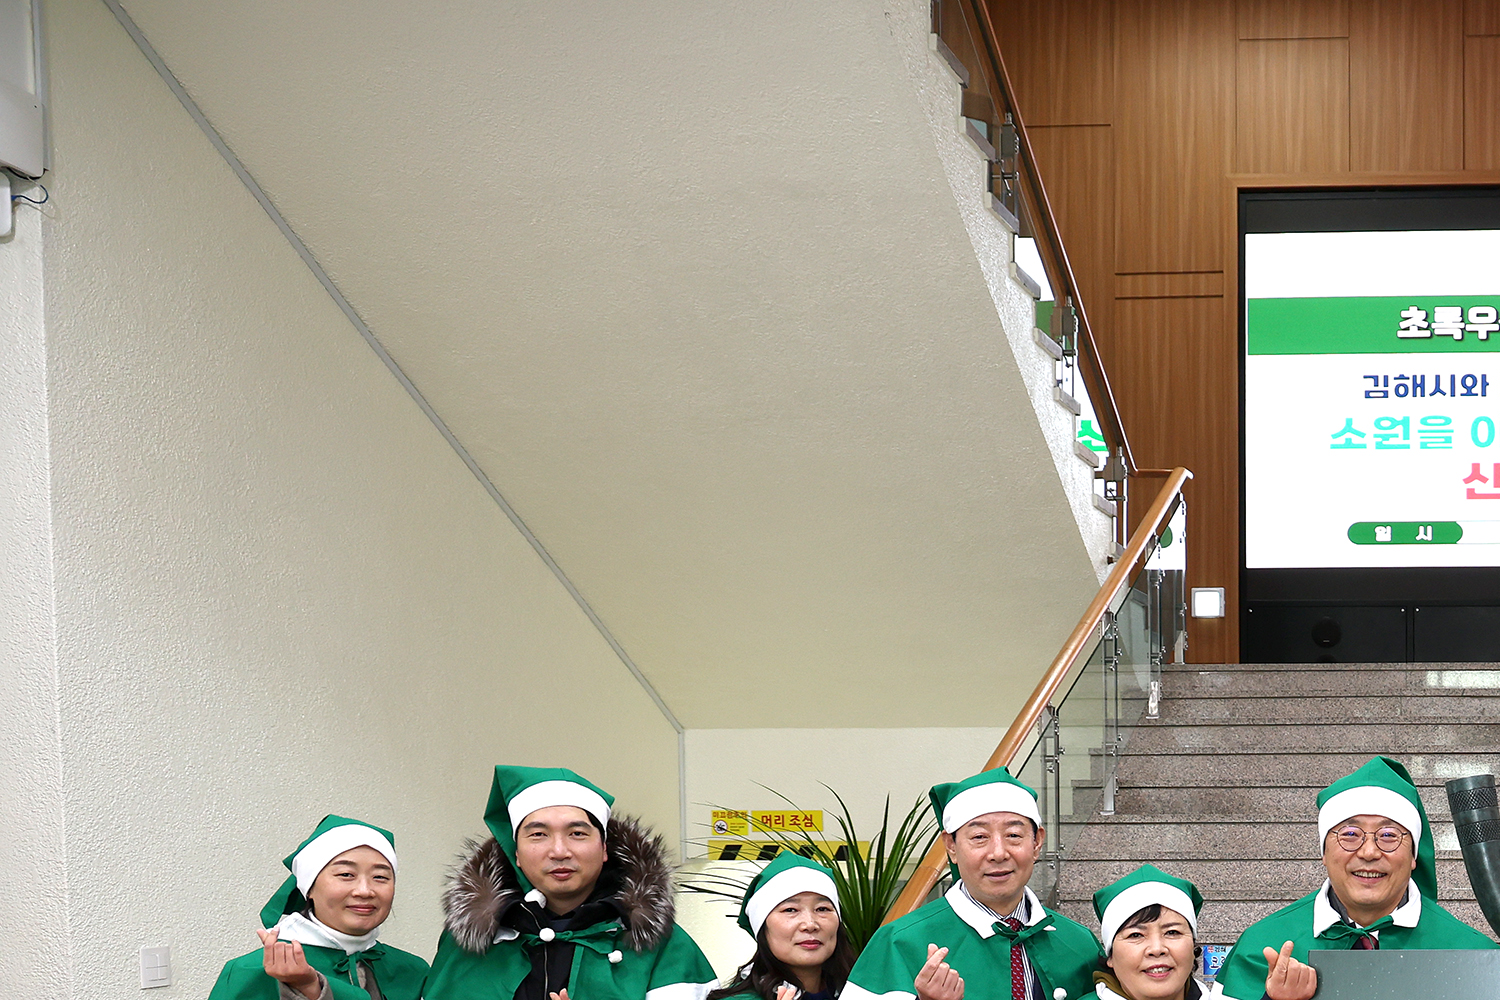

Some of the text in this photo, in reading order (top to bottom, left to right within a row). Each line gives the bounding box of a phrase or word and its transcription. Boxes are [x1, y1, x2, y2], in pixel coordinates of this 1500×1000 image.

[1362, 374, 1490, 400] 김해시와
[1329, 416, 1454, 450] 소원을
[761, 814, 785, 828] 머리
[789, 814, 814, 828] 조심
